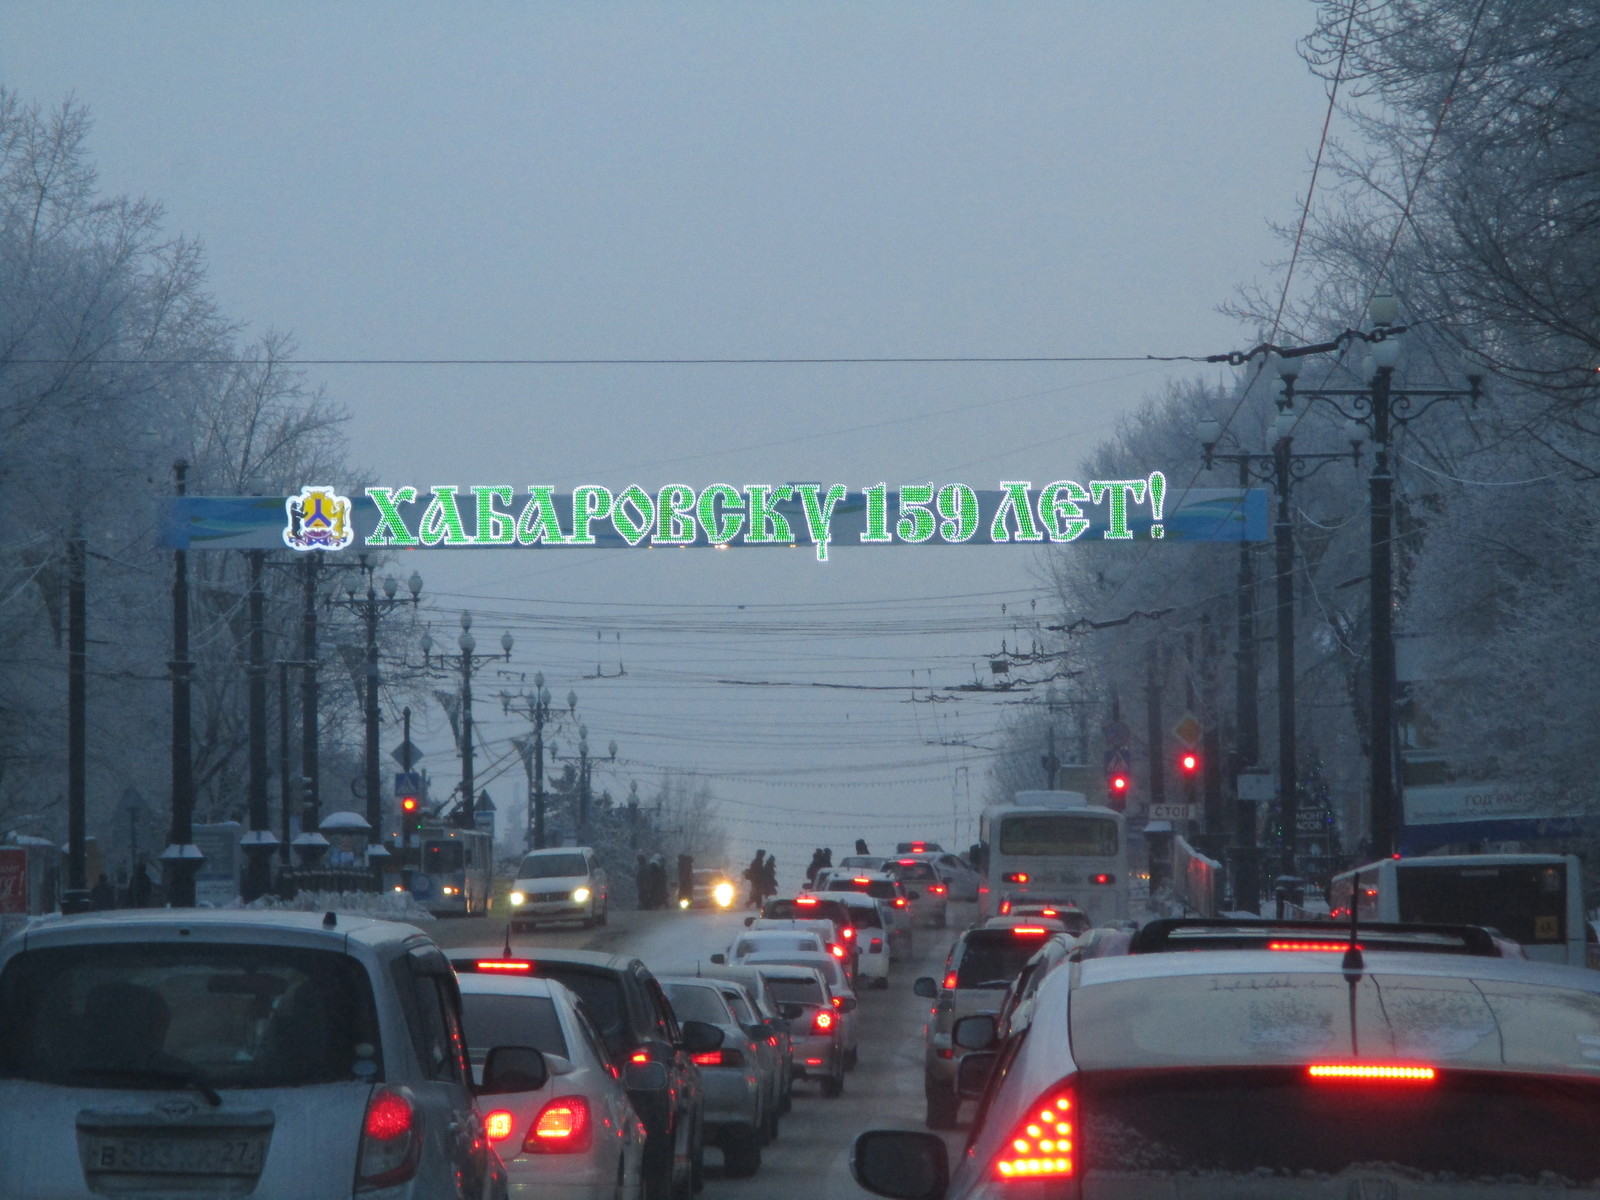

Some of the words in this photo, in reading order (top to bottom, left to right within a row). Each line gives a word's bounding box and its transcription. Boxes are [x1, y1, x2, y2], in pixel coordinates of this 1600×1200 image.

[364, 483, 847, 561] ХАБАРОВСКУ
[859, 480, 980, 543] 159
[990, 470, 1167, 544] ЛЕТ!
[1155, 806, 1188, 817] СТОП
